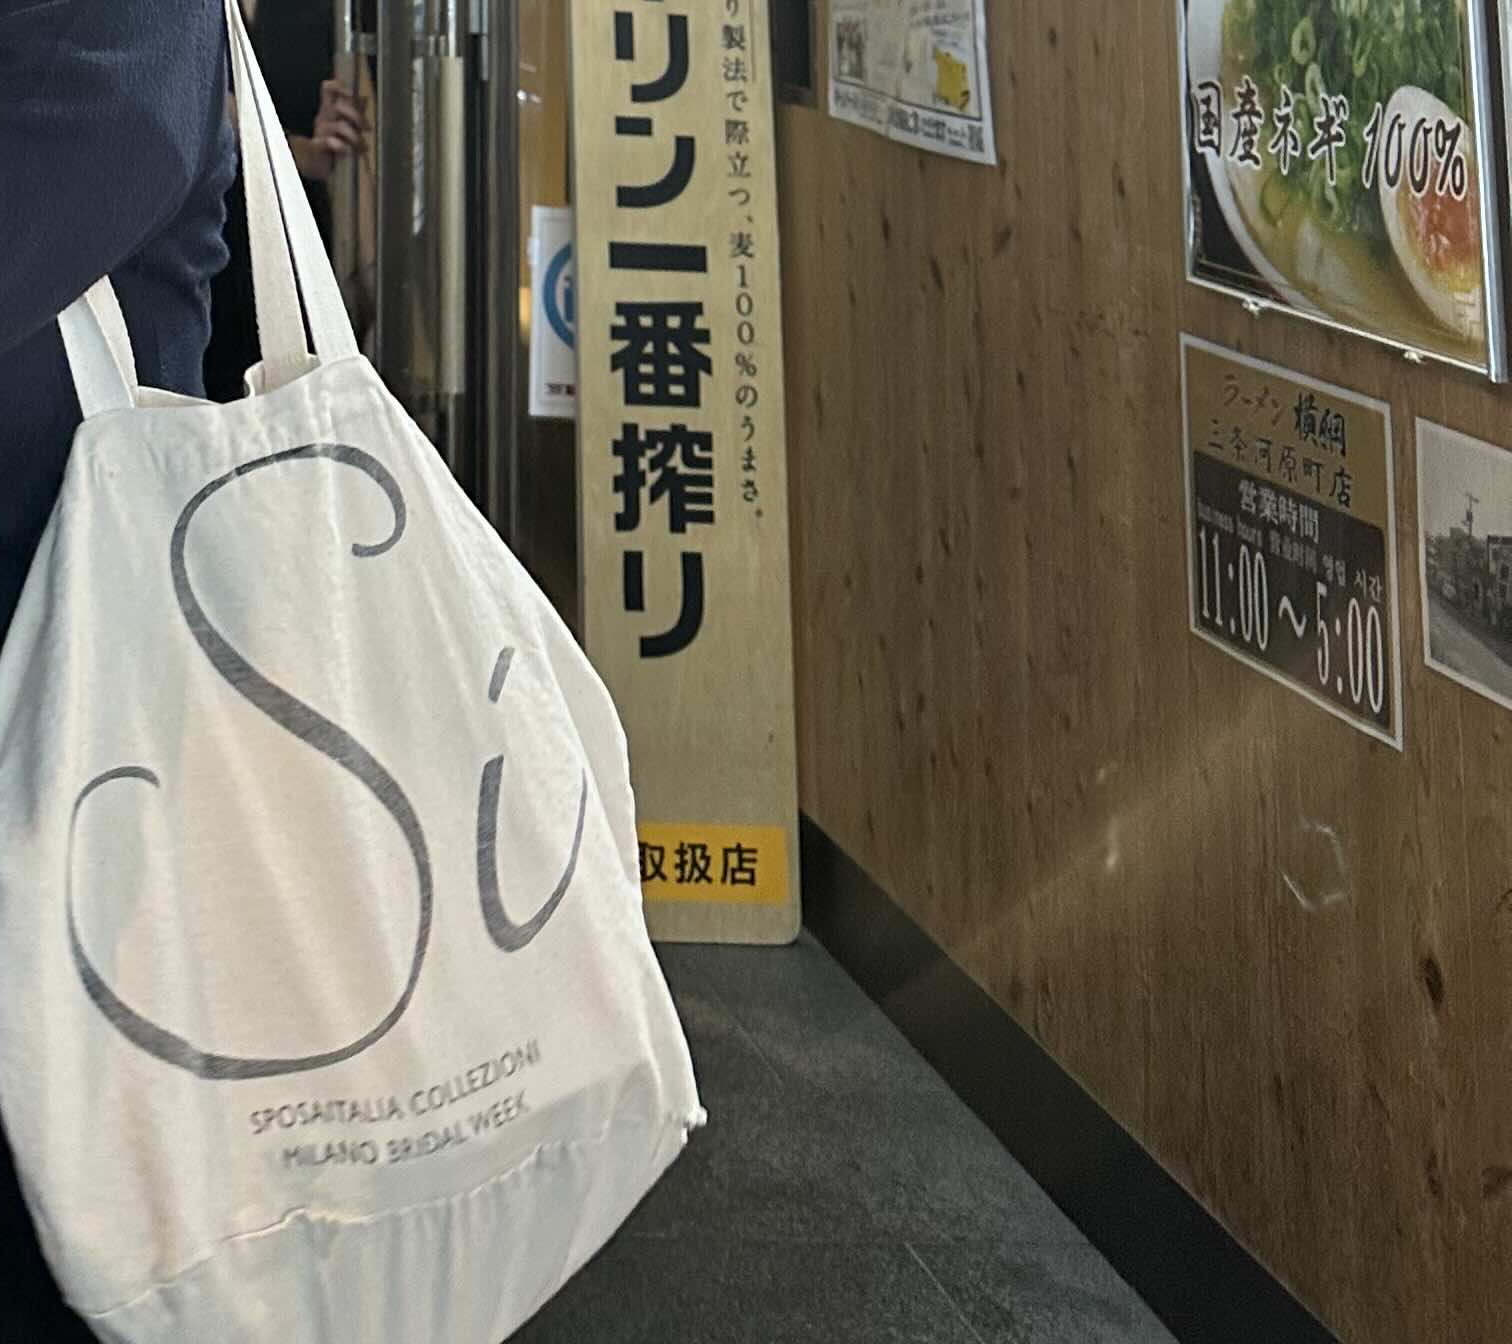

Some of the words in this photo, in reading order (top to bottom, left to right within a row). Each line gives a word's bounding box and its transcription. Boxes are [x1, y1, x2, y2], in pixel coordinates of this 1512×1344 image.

[638, 840, 758, 886] 取扱店
[249, 1095, 404, 1135] SPOSAITALIA
[409, 1039, 542, 1116] COLLEZIONI
[282, 1140, 379, 1167] MILANO
[386, 1124, 469, 1163] BRIDAL
[470, 1090, 531, 1135] WEEK
